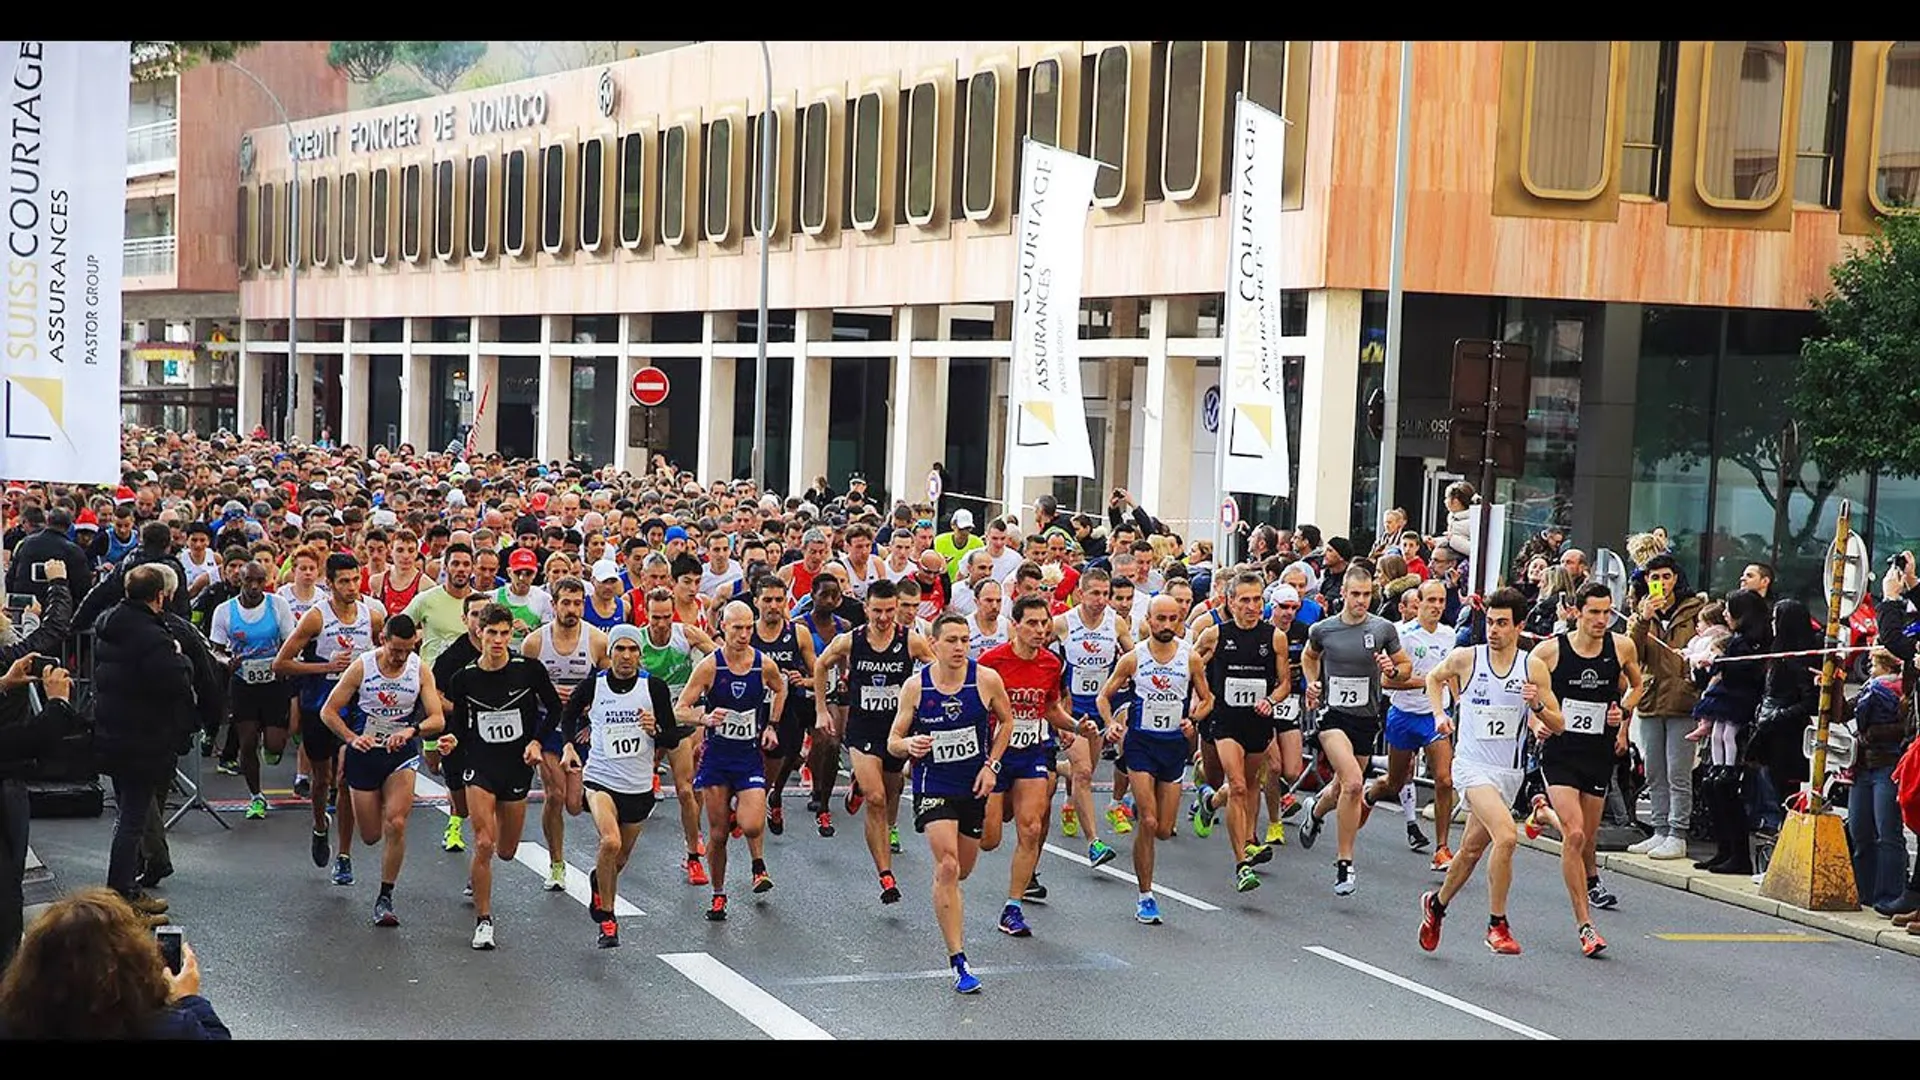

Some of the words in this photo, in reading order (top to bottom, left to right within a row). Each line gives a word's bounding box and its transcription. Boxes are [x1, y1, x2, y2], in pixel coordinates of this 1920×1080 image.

[351, 112, 420, 154] FONCIER
[433, 105, 456, 141] DE
[469, 88, 548, 136] MONACO
[48, 188, 69, 364] ASSURANCES
[86, 254, 100, 306] GROUP
[1034, 266, 1052, 392] ASSURANCES
[85, 310, 99, 365] PASTOR
[861, 661, 905, 673] FRANCE
[1082, 680, 1099, 692] 50
[1233, 691, 1256, 703] 111
[1340, 691, 1358, 703] 73
[1276, 704, 1291, 717] 57
[1153, 715, 1171, 729] 51
[1487, 720, 1506, 736] 12
[1572, 715, 1593, 730] 28
[487, 724, 514, 740] 110
[722, 723, 752, 737] 1701
[612, 737, 640, 755] 107
[1012, 731, 1037, 746] 702
[937, 741, 976, 760] 1703
